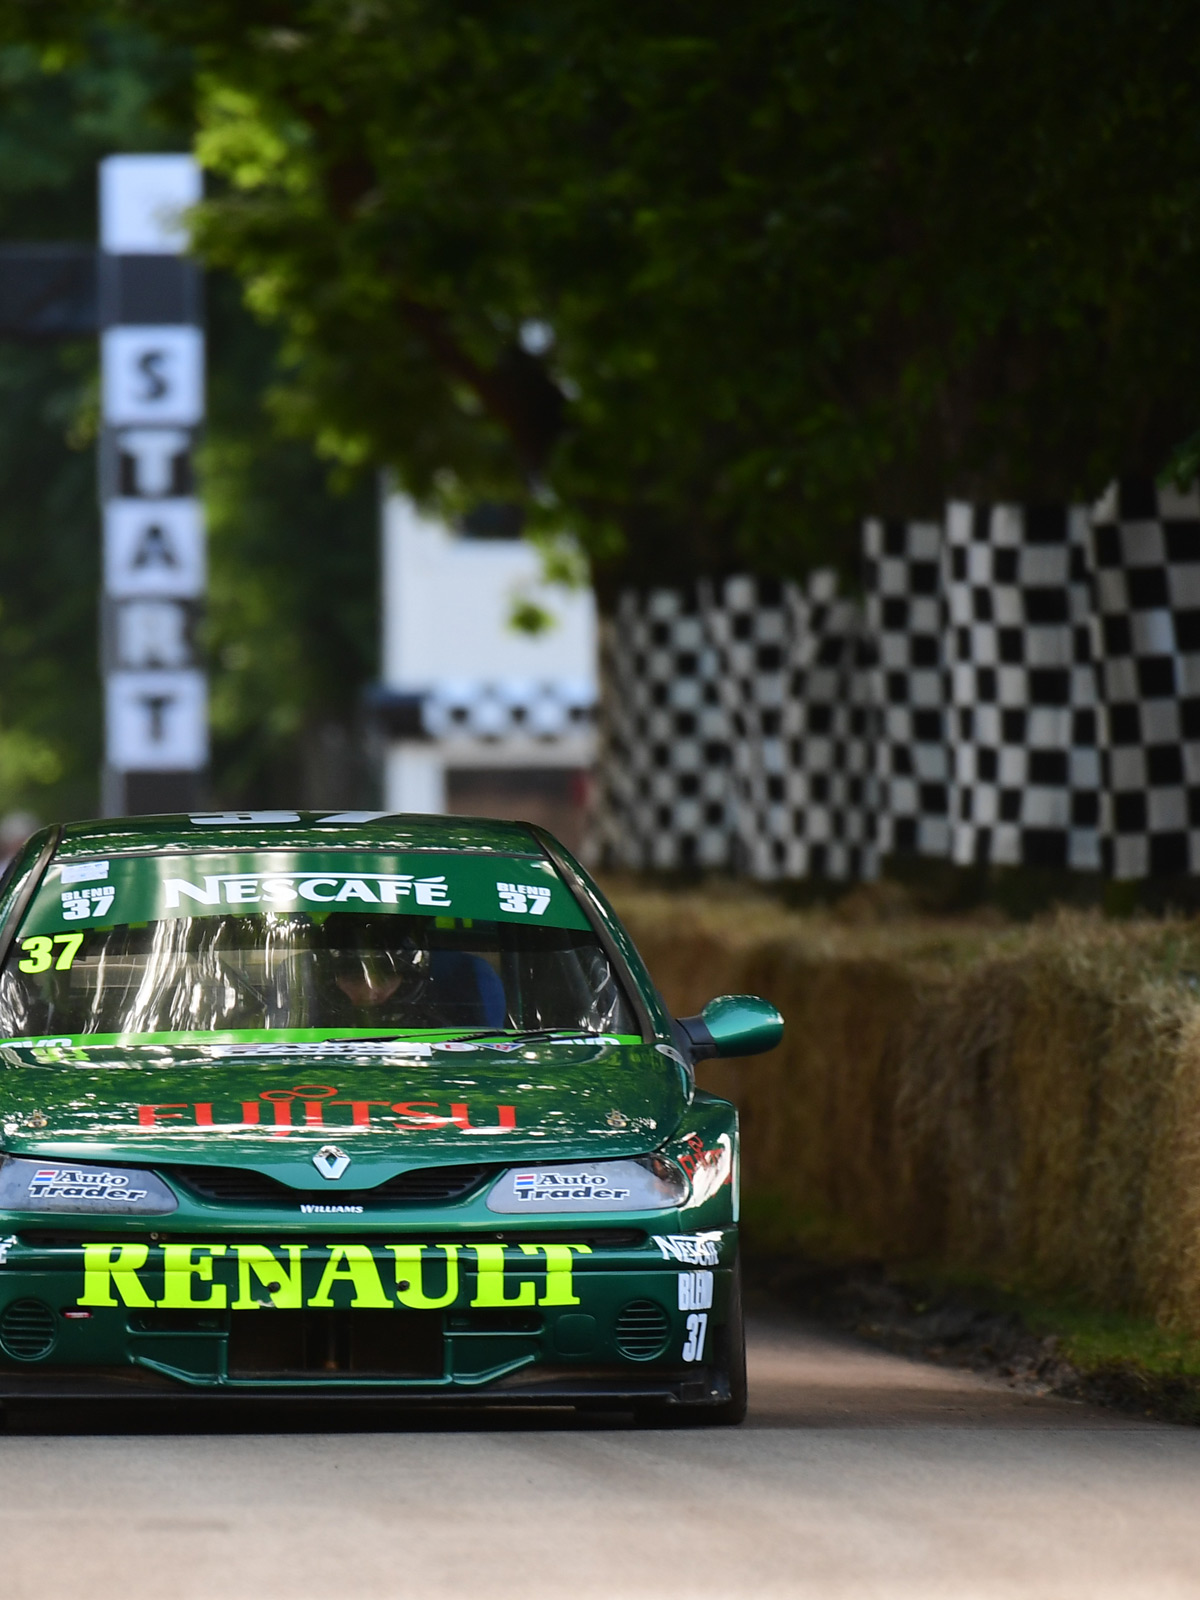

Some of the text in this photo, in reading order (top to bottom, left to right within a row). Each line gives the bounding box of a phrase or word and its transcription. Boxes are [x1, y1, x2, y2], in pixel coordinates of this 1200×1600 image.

[117, 347, 189, 746] START
[61, 886, 116, 902] BLEND
[163, 872, 452, 908] NESCAFÉ
[496, 881, 551, 897] BLEND
[62, 895, 115, 921] 37
[498, 891, 551, 916] 37
[19, 932, 85, 974] 37
[136, 1085, 517, 1141] FUJITSU
[58, 1171, 128, 1186] Auto
[539, 1173, 607, 1186] Auto
[29, 1184, 146, 1201] Trader
[515, 1186, 628, 1200] Trader
[300, 1204, 364, 1214] WILLIAMS
[76, 1243, 593, 1310] RENAULT
[681, 1313, 708, 1362] 37
